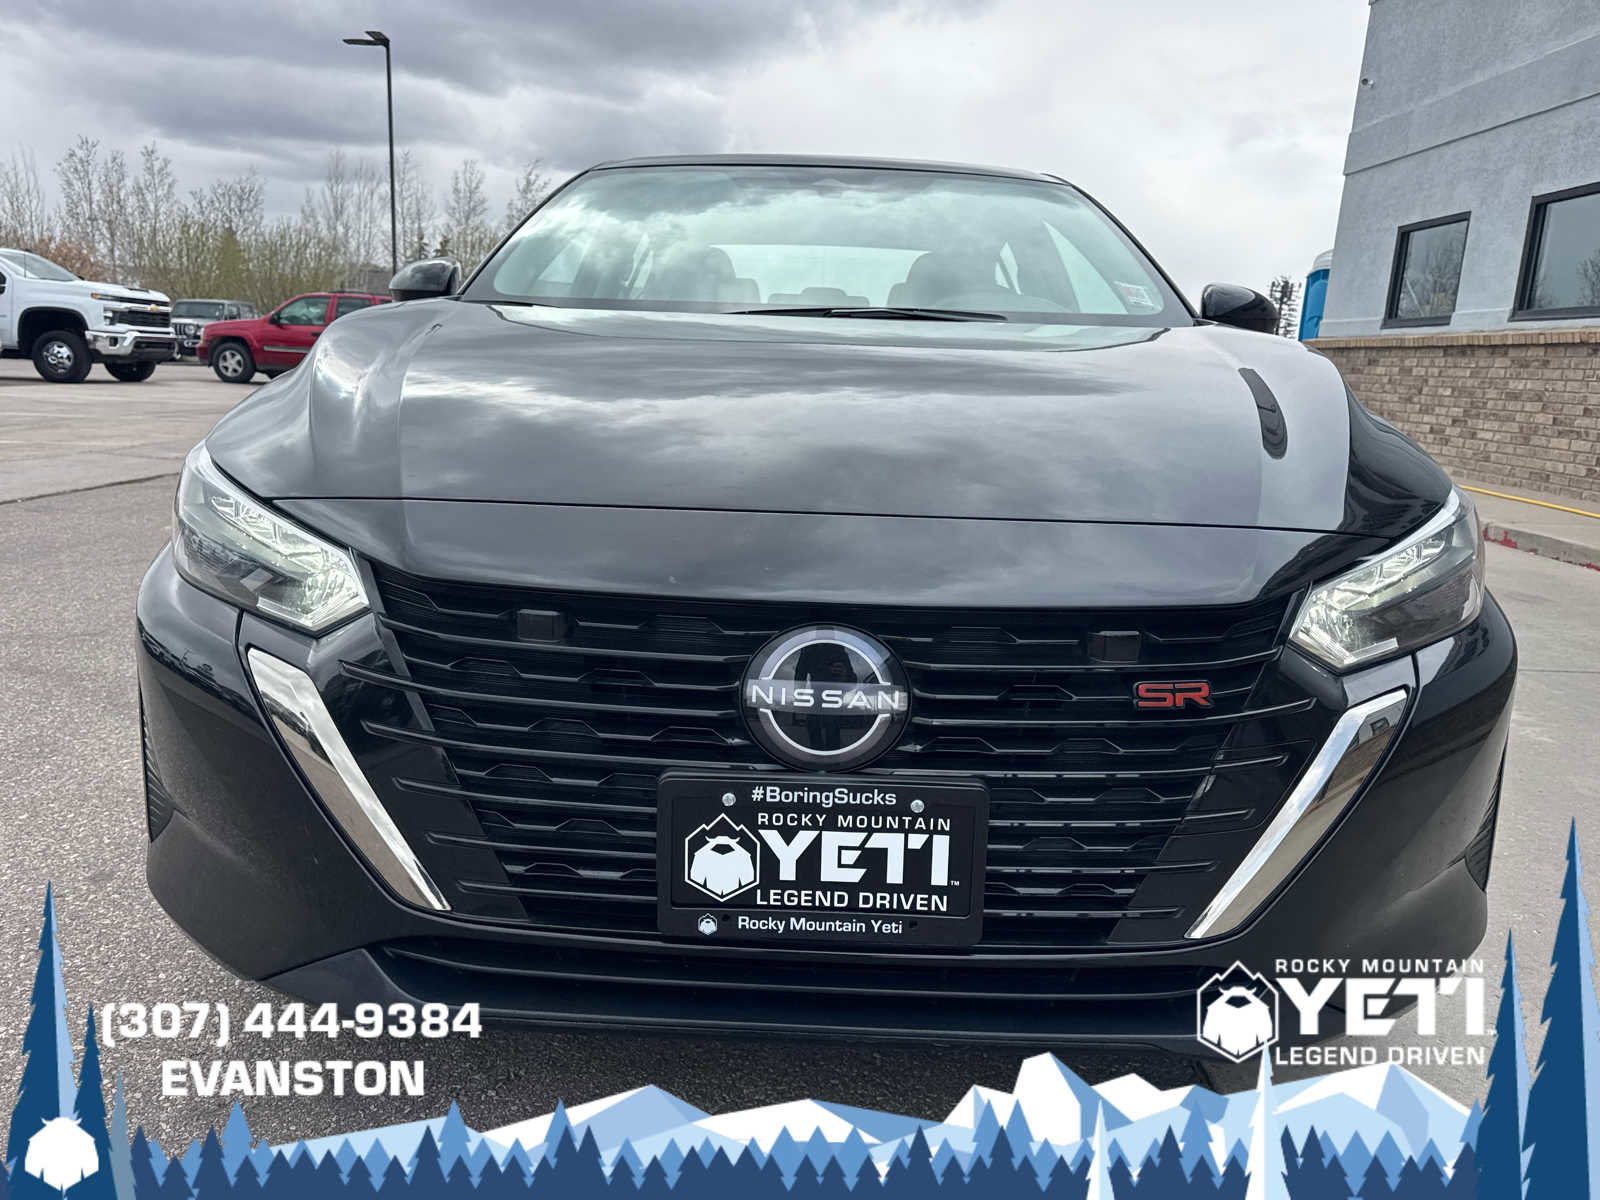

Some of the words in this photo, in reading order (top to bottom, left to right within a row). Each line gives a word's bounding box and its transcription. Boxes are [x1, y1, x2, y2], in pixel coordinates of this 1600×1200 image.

[751, 683, 900, 710] NISSAN
[1137, 682, 1211, 707] SR
[751, 786, 897, 807] #BoringSucks
[757, 813, 827, 826] ROCKY
[837, 815, 951, 831] MOUNTAIN
[757, 829, 950, 886] YETI
[756, 889, 849, 907] LEGEND
[858, 892, 948, 911] DRIVEN
[737, 916, 785, 933] Rocky
[790, 917, 865, 933] Mountain
[870, 919, 903, 934] Yeti
